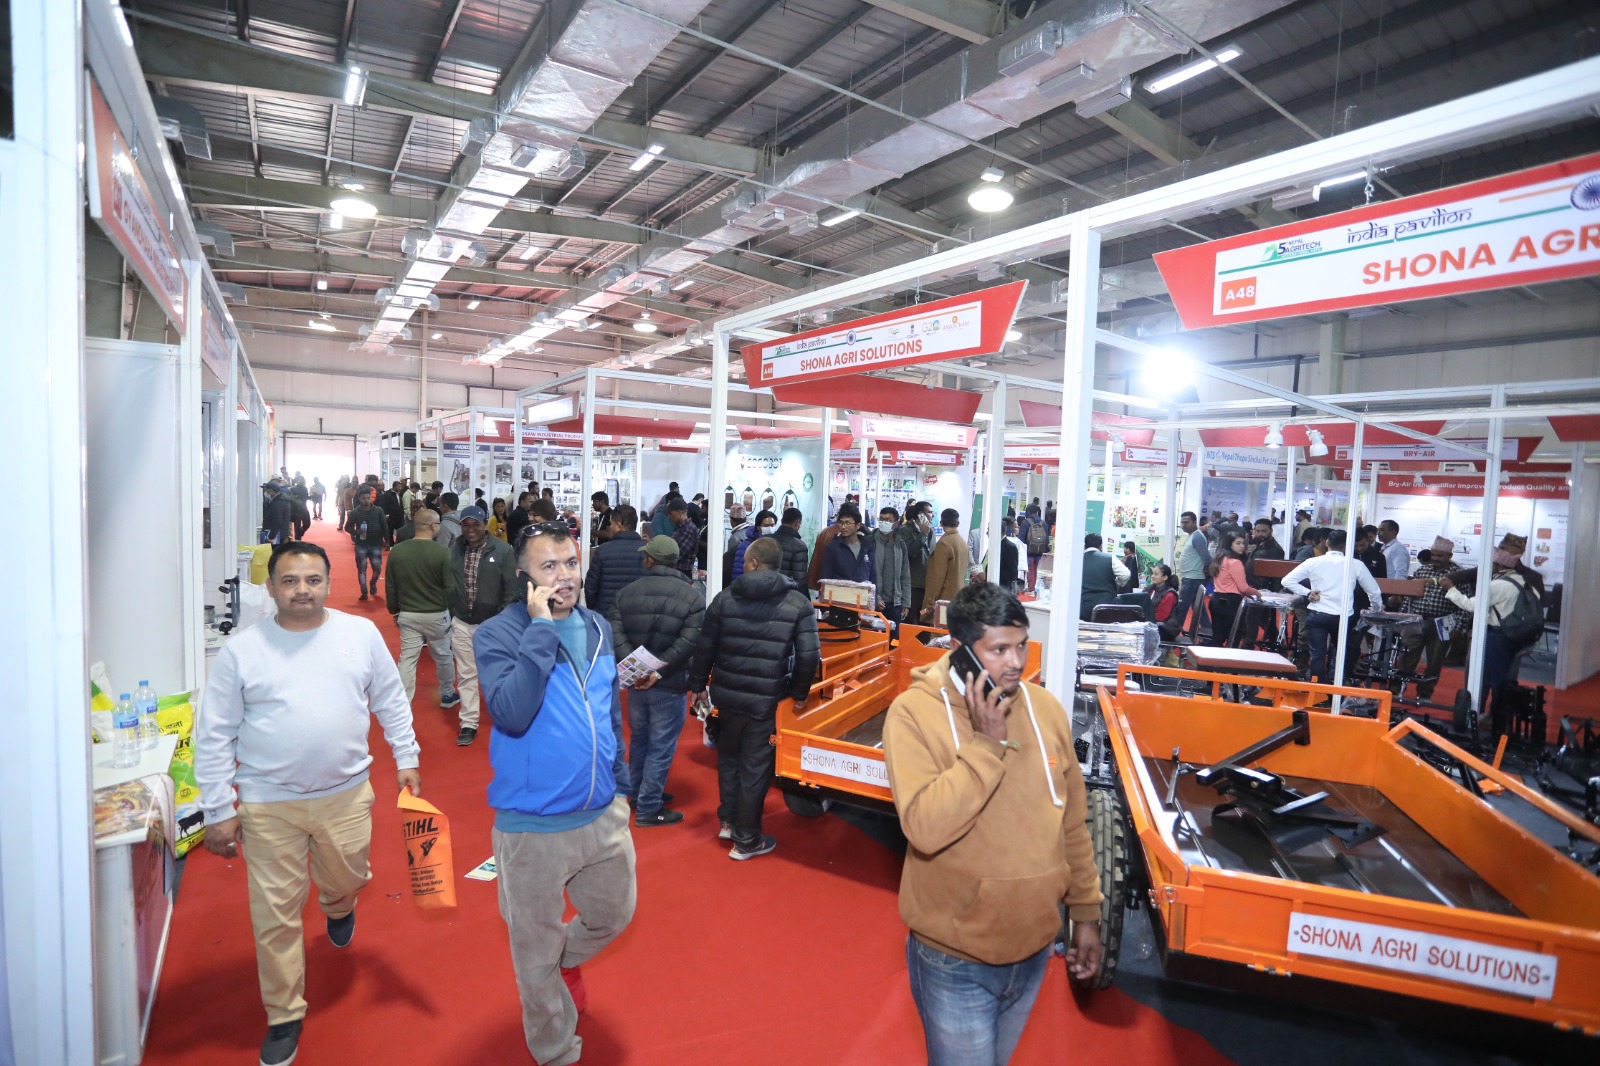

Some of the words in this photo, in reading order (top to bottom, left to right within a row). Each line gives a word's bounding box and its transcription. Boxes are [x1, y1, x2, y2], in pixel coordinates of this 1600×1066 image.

[1347, 222, 1388, 243] india
[1394, 208, 1473, 240] pavilion
[1285, 241, 1321, 253] AGRITECH
[1362, 242, 1496, 285] SHONA
[1225, 286, 1255, 301] A48
[800, 355, 832, 371] SHONA
[834, 350, 858, 366] AGRI
[859, 339, 923, 362] SOLUTIONS
[1222, 452, 1234, 461] Nepal
[806, 753, 837, 769] SHONA
[840, 760, 861, 774] AGRI
[866, 765, 888, 780] SOLU
[1300, 924, 1361, 952] SHONA
[1371, 936, 1417, 962] AGRI
[1427, 945, 1541, 986] SOLUTIONS
